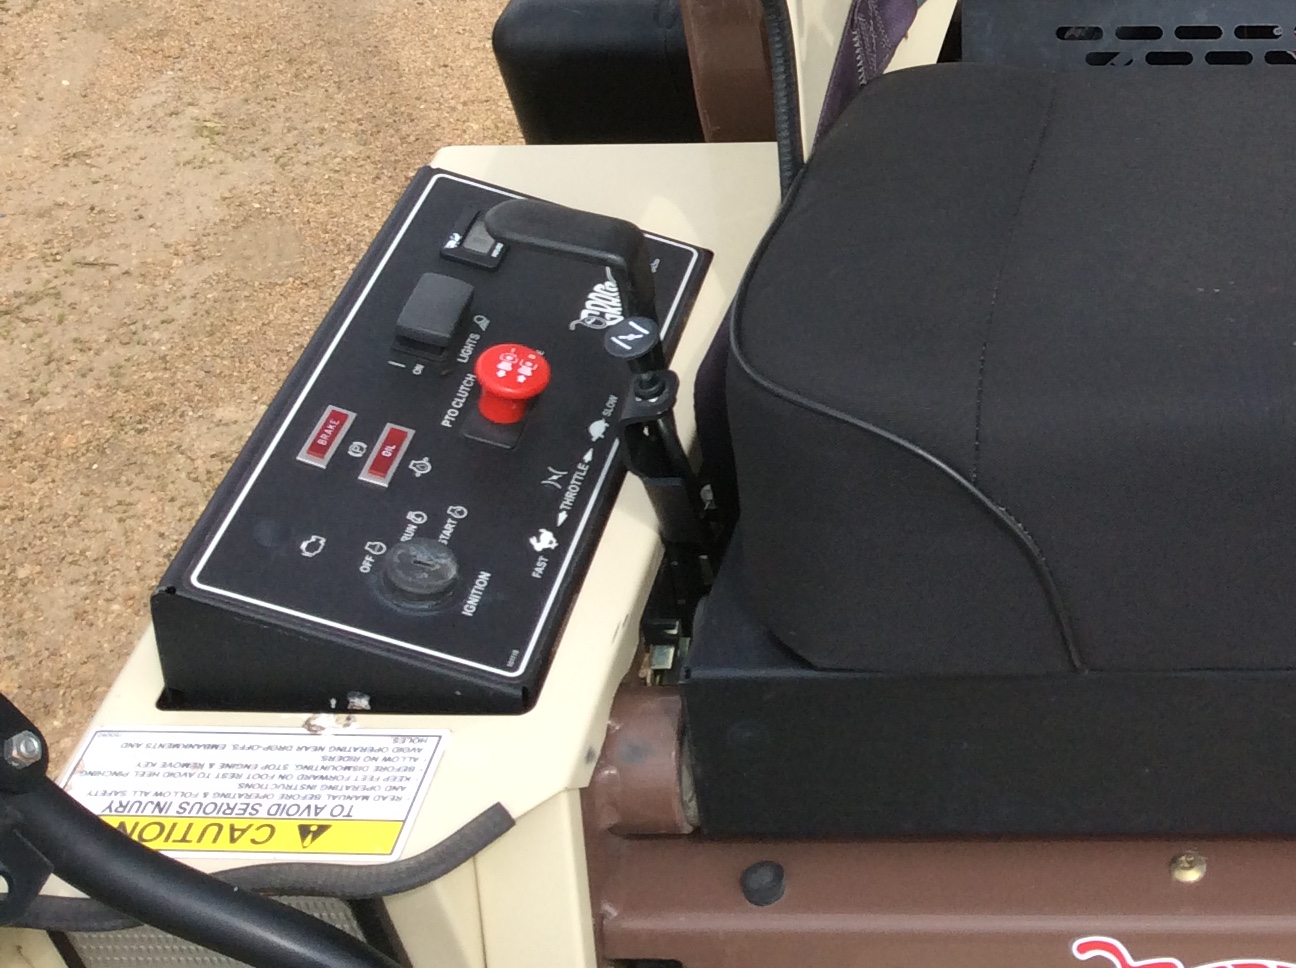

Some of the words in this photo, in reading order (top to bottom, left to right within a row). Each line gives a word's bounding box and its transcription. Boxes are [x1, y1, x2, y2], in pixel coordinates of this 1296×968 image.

[456, 333, 481, 364] LIGHTS
[440, 404, 459, 428] PTO
[451, 373, 477, 410] CLUTCH
[602, 394, 619, 417] SLOW
[317, 419, 341, 447] BRAKE
[381, 443, 397, 458] OIL
[559, 462, 590, 510] THROTTLE
[401, 524, 418, 541] RUN
[359, 555, 376, 573] OFF
[532, 555, 549, 579] FAST
[461, 571, 492, 617] IGNITION
[212, 792, 274, 800] OPERATING
[101, 800, 173, 814] INJURY
[176, 801, 262, 816] SERIOUS
[267, 803, 327, 817] AVOID
[330, 804, 354, 818] TO
